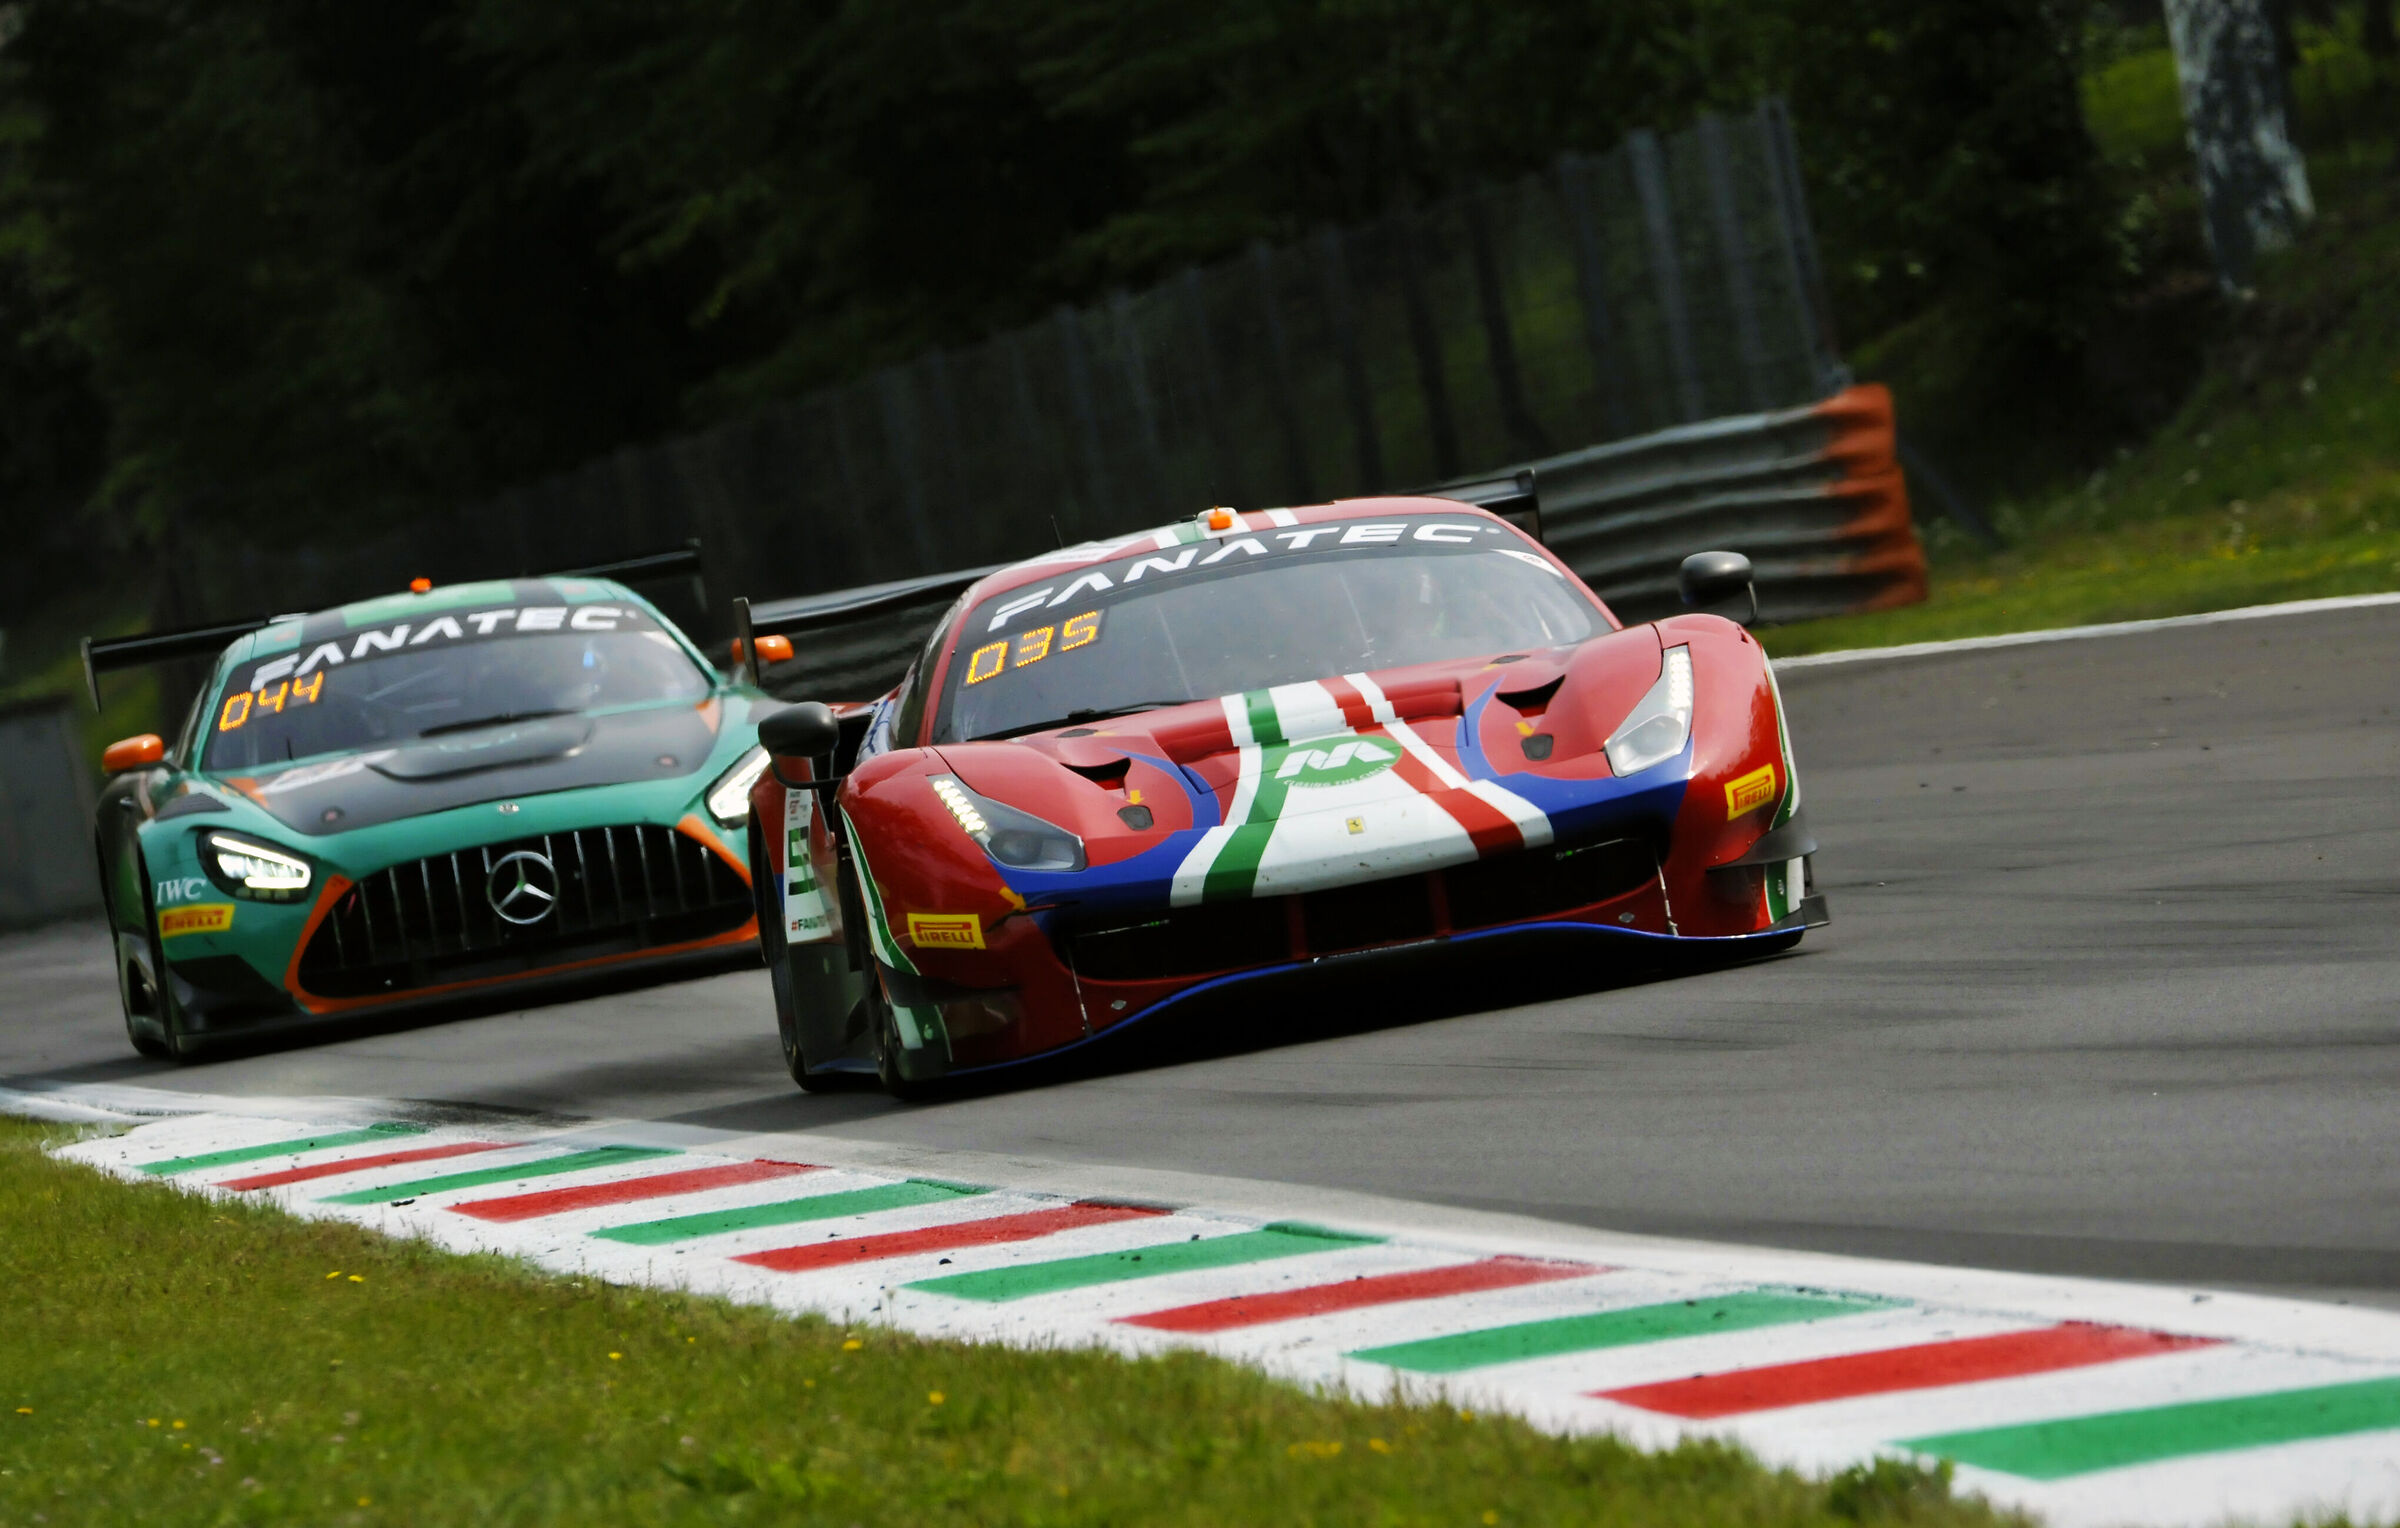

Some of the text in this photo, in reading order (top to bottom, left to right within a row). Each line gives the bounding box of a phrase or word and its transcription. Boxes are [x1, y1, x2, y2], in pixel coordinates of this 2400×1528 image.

[987, 523, 1481, 633] FANATEC
[250, 606, 623, 692] FANATEC
[965, 610, 1098, 685] 035
[218, 670, 325, 732] 044
[1732, 773, 1773, 812] PIRELLI
[156, 876, 207, 906] IWC
[914, 921, 976, 944] PIRELLI
